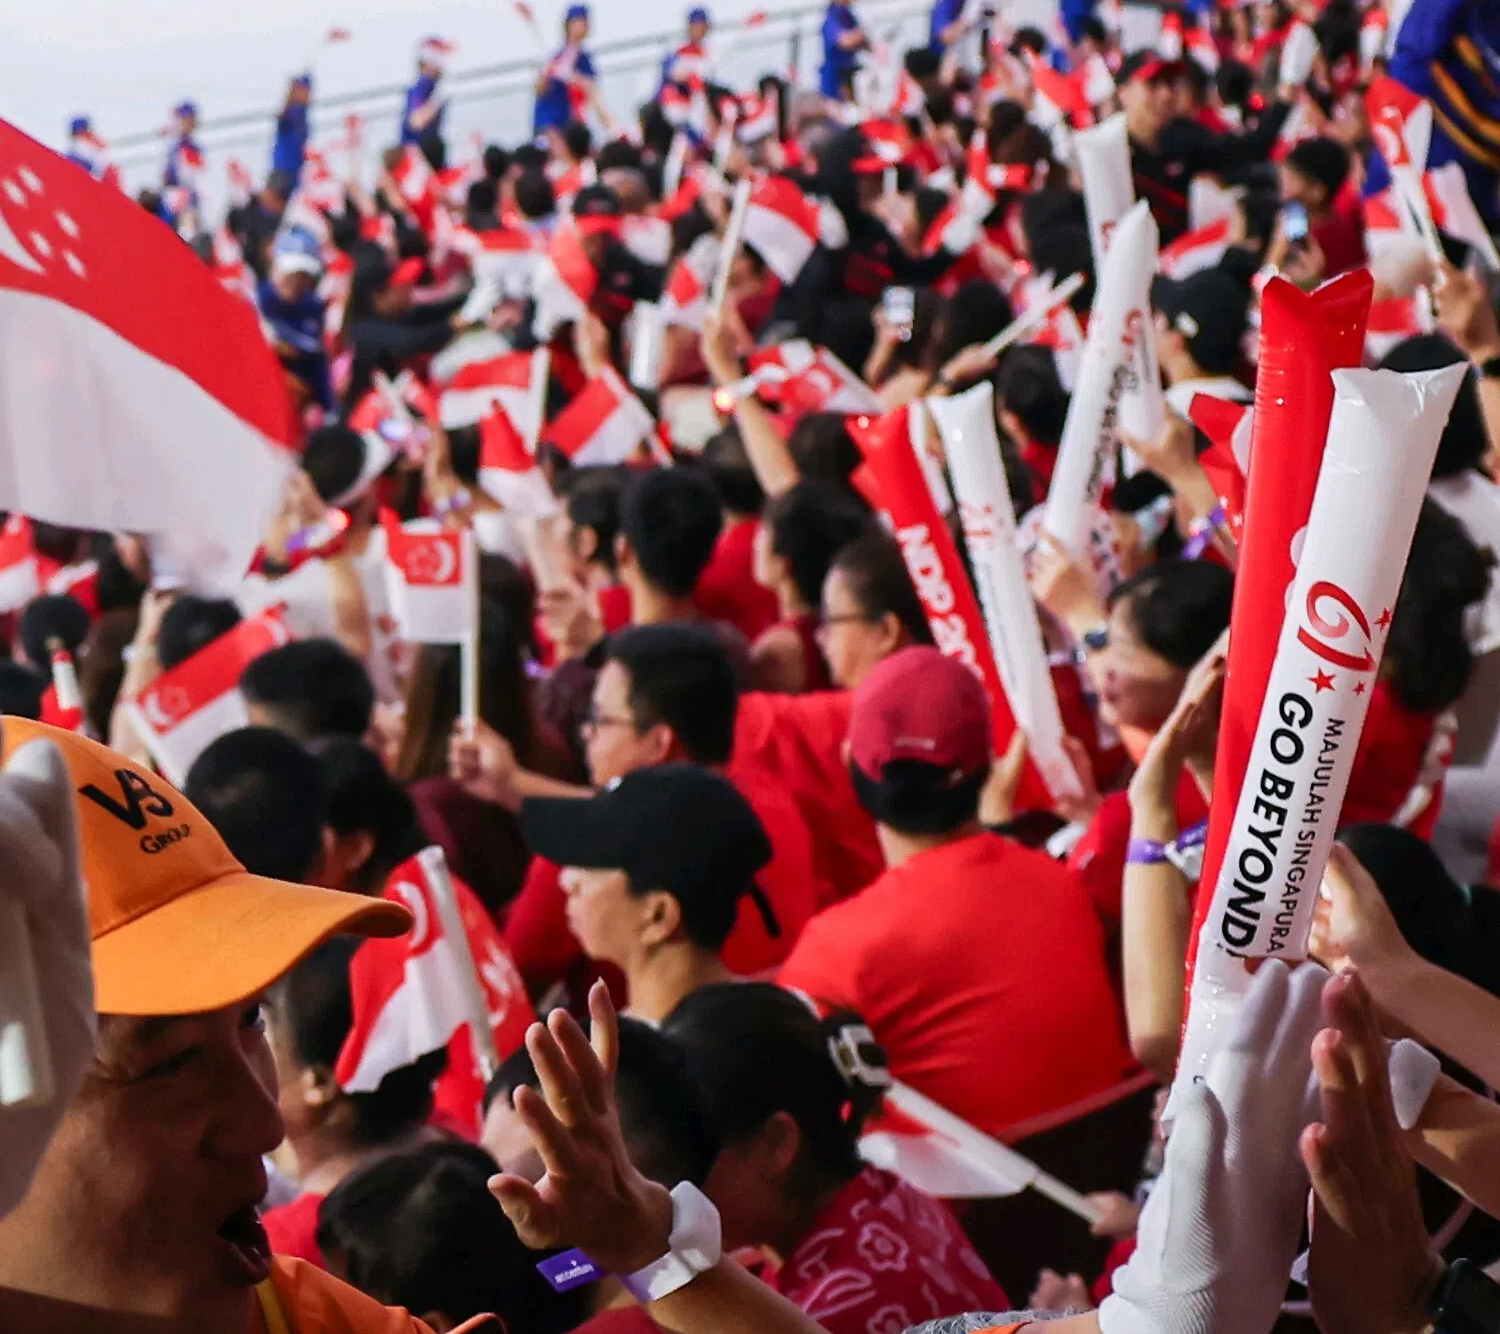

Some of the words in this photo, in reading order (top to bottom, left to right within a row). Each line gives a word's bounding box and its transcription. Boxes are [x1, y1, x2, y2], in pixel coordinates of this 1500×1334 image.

[896, 523, 956, 614] NDP
[1269, 692, 1314, 765] GO
[1299, 717, 1346, 824] MAJULAH
[1217, 767, 1296, 960] BEYOND!
[1265, 829, 1316, 955] SINGAPURA
